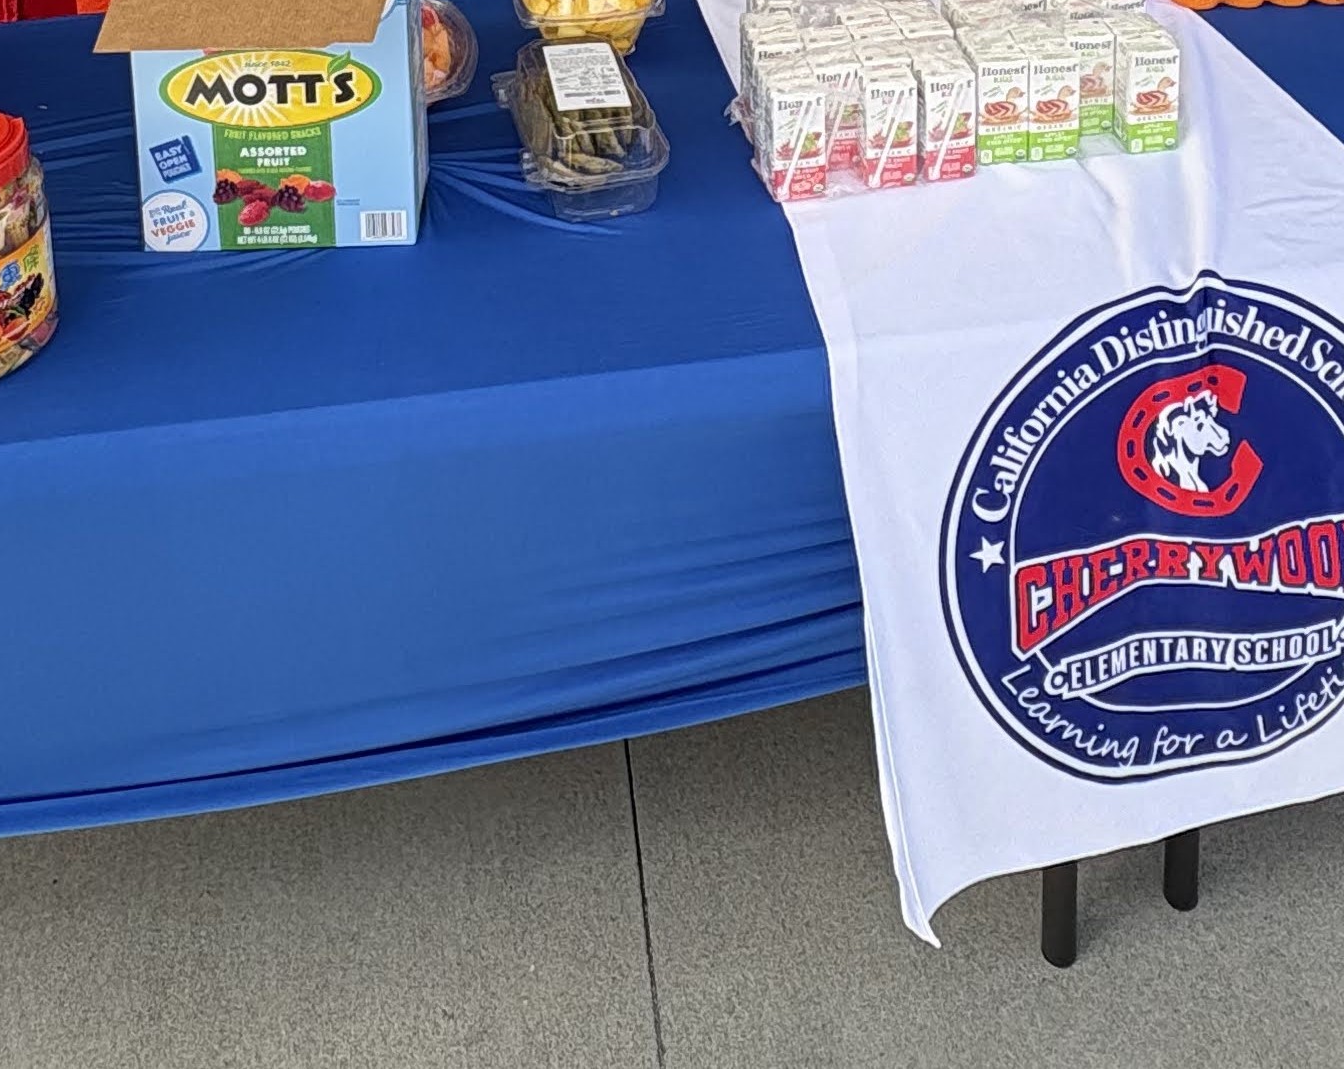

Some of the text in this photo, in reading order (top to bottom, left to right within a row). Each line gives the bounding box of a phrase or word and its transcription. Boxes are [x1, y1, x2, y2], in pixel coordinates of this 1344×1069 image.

[1135, 55, 1179, 67] Honest
[982, 65, 1026, 77] Honest
[1034, 64, 1078, 75] Honest
[154, 145, 183, 162] EASY
[240, 146, 307, 158] ASSORTED
[159, 156, 188, 170] OPEN
[257, 158, 291, 167] FRUIT
[153, 211, 186, 227] FRUIT
[151, 219, 196, 238] VEGGIE
[971, 369, 1102, 523] California
[1089, 298, 1312, 376] Distinguished
[1070, 627, 1336, 691] ELEMENTARY SCHOOL
[1001, 664, 1140, 768] Learning
[1150, 726, 1206, 766] for
[1217, 725, 1249, 750] a
